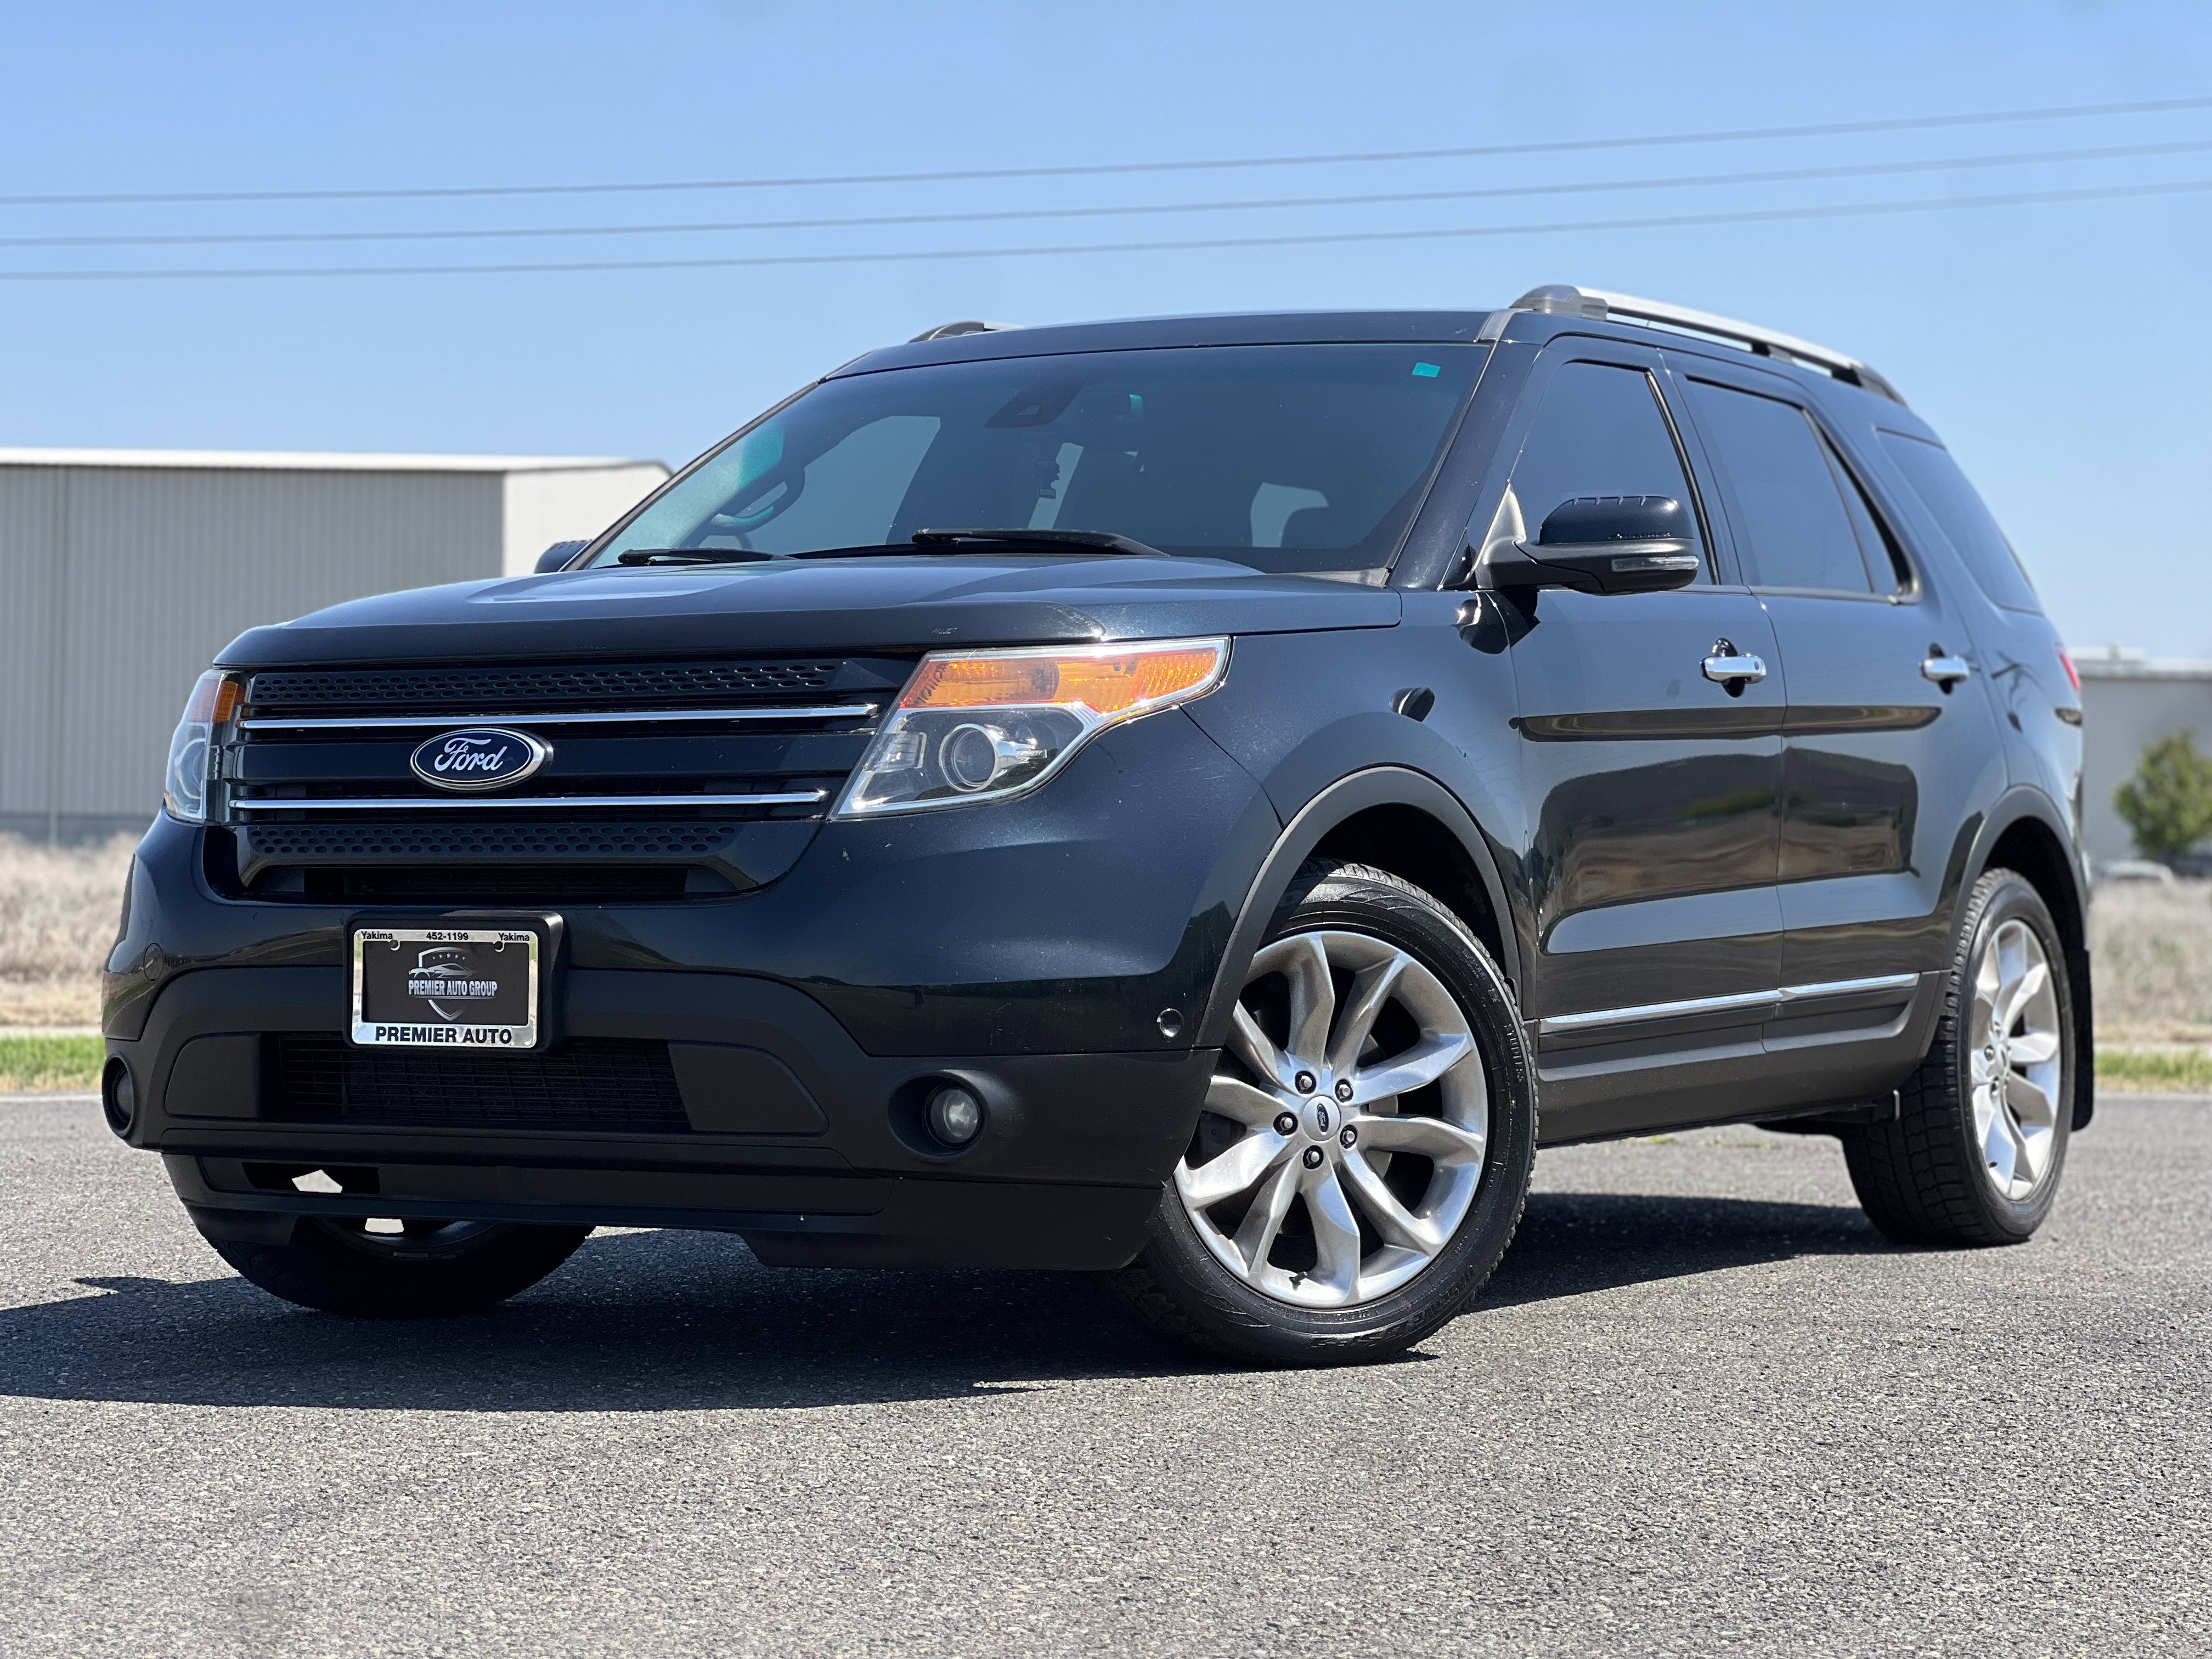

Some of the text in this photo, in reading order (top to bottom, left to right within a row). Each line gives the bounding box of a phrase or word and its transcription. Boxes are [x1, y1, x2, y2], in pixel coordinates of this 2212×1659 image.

[434, 738, 508, 771] Ford
[361, 931, 530, 942] Yakima 452-1199 Yakima
[408, 980, 498, 997] PREMIER AUTO GROUP
[375, 1027, 512, 1044] PREMIER AUTO
